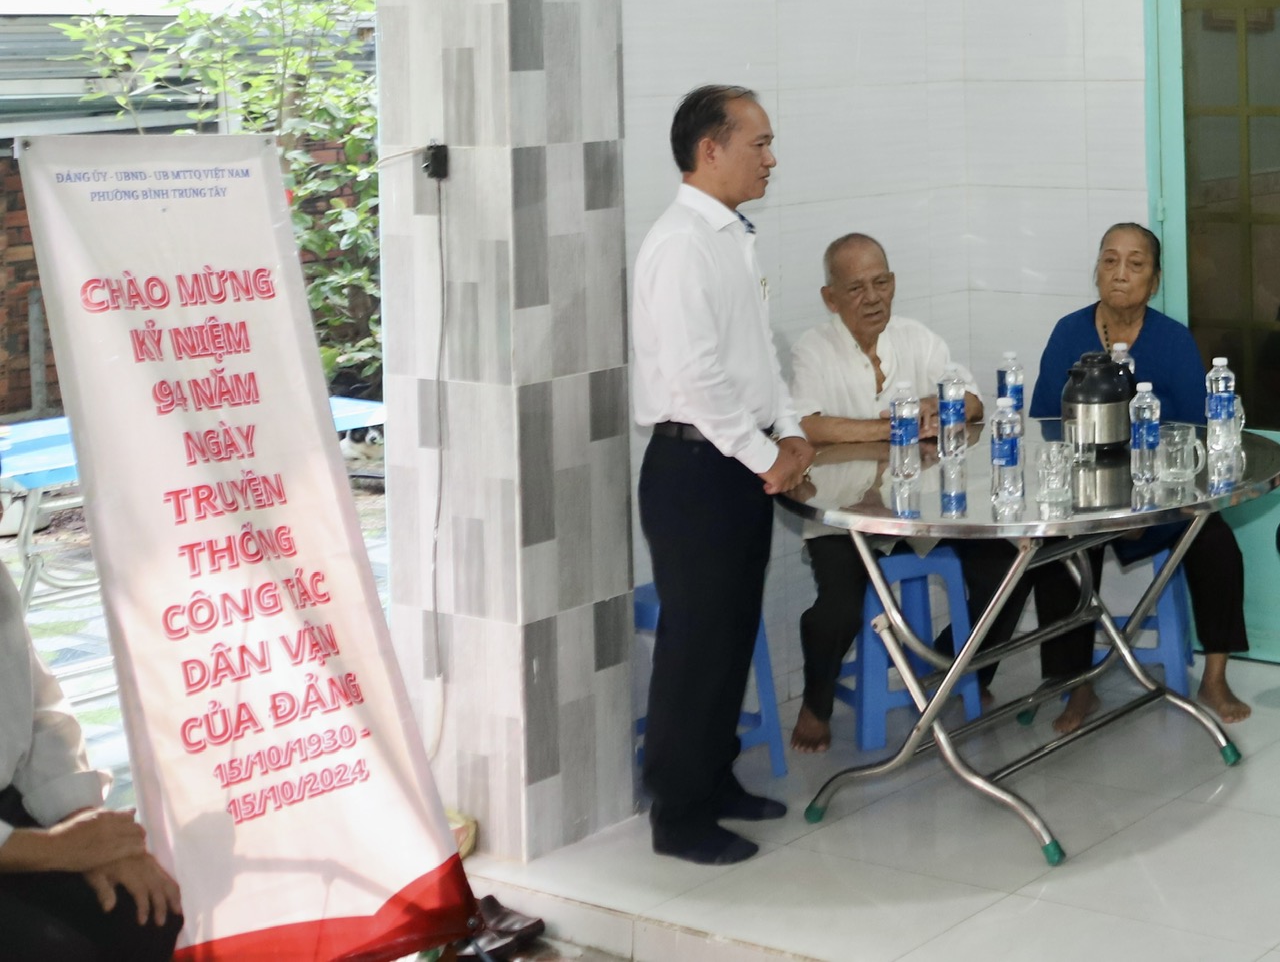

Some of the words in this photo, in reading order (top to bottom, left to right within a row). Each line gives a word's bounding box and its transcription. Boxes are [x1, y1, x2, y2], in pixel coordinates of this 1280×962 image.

[79, 270, 170, 313] CHÀO
[176, 264, 276, 307] MỪNG
[130, 319, 164, 364] KỶ
[168, 316, 251, 364] NIỆM
[152, 379, 188, 416] 94
[188, 368, 260, 412] NĂM
[183, 422, 256, 466] NGÀY
[163, 469, 288, 526] TRUYỀN
[178, 522, 297, 579] THỐNG
[161, 581, 285, 640] CÔNG
[283, 568, 331, 611] TÁC
[180, 641, 271, 697] DÂN
[279, 620, 340, 668] VẬN
[180, 700, 264, 755] CỦA
[268, 672, 365, 731] ĐẢNG
[213, 723, 358, 789] 15/10/1930
[226, 758, 371, 826] 15/10/2024
